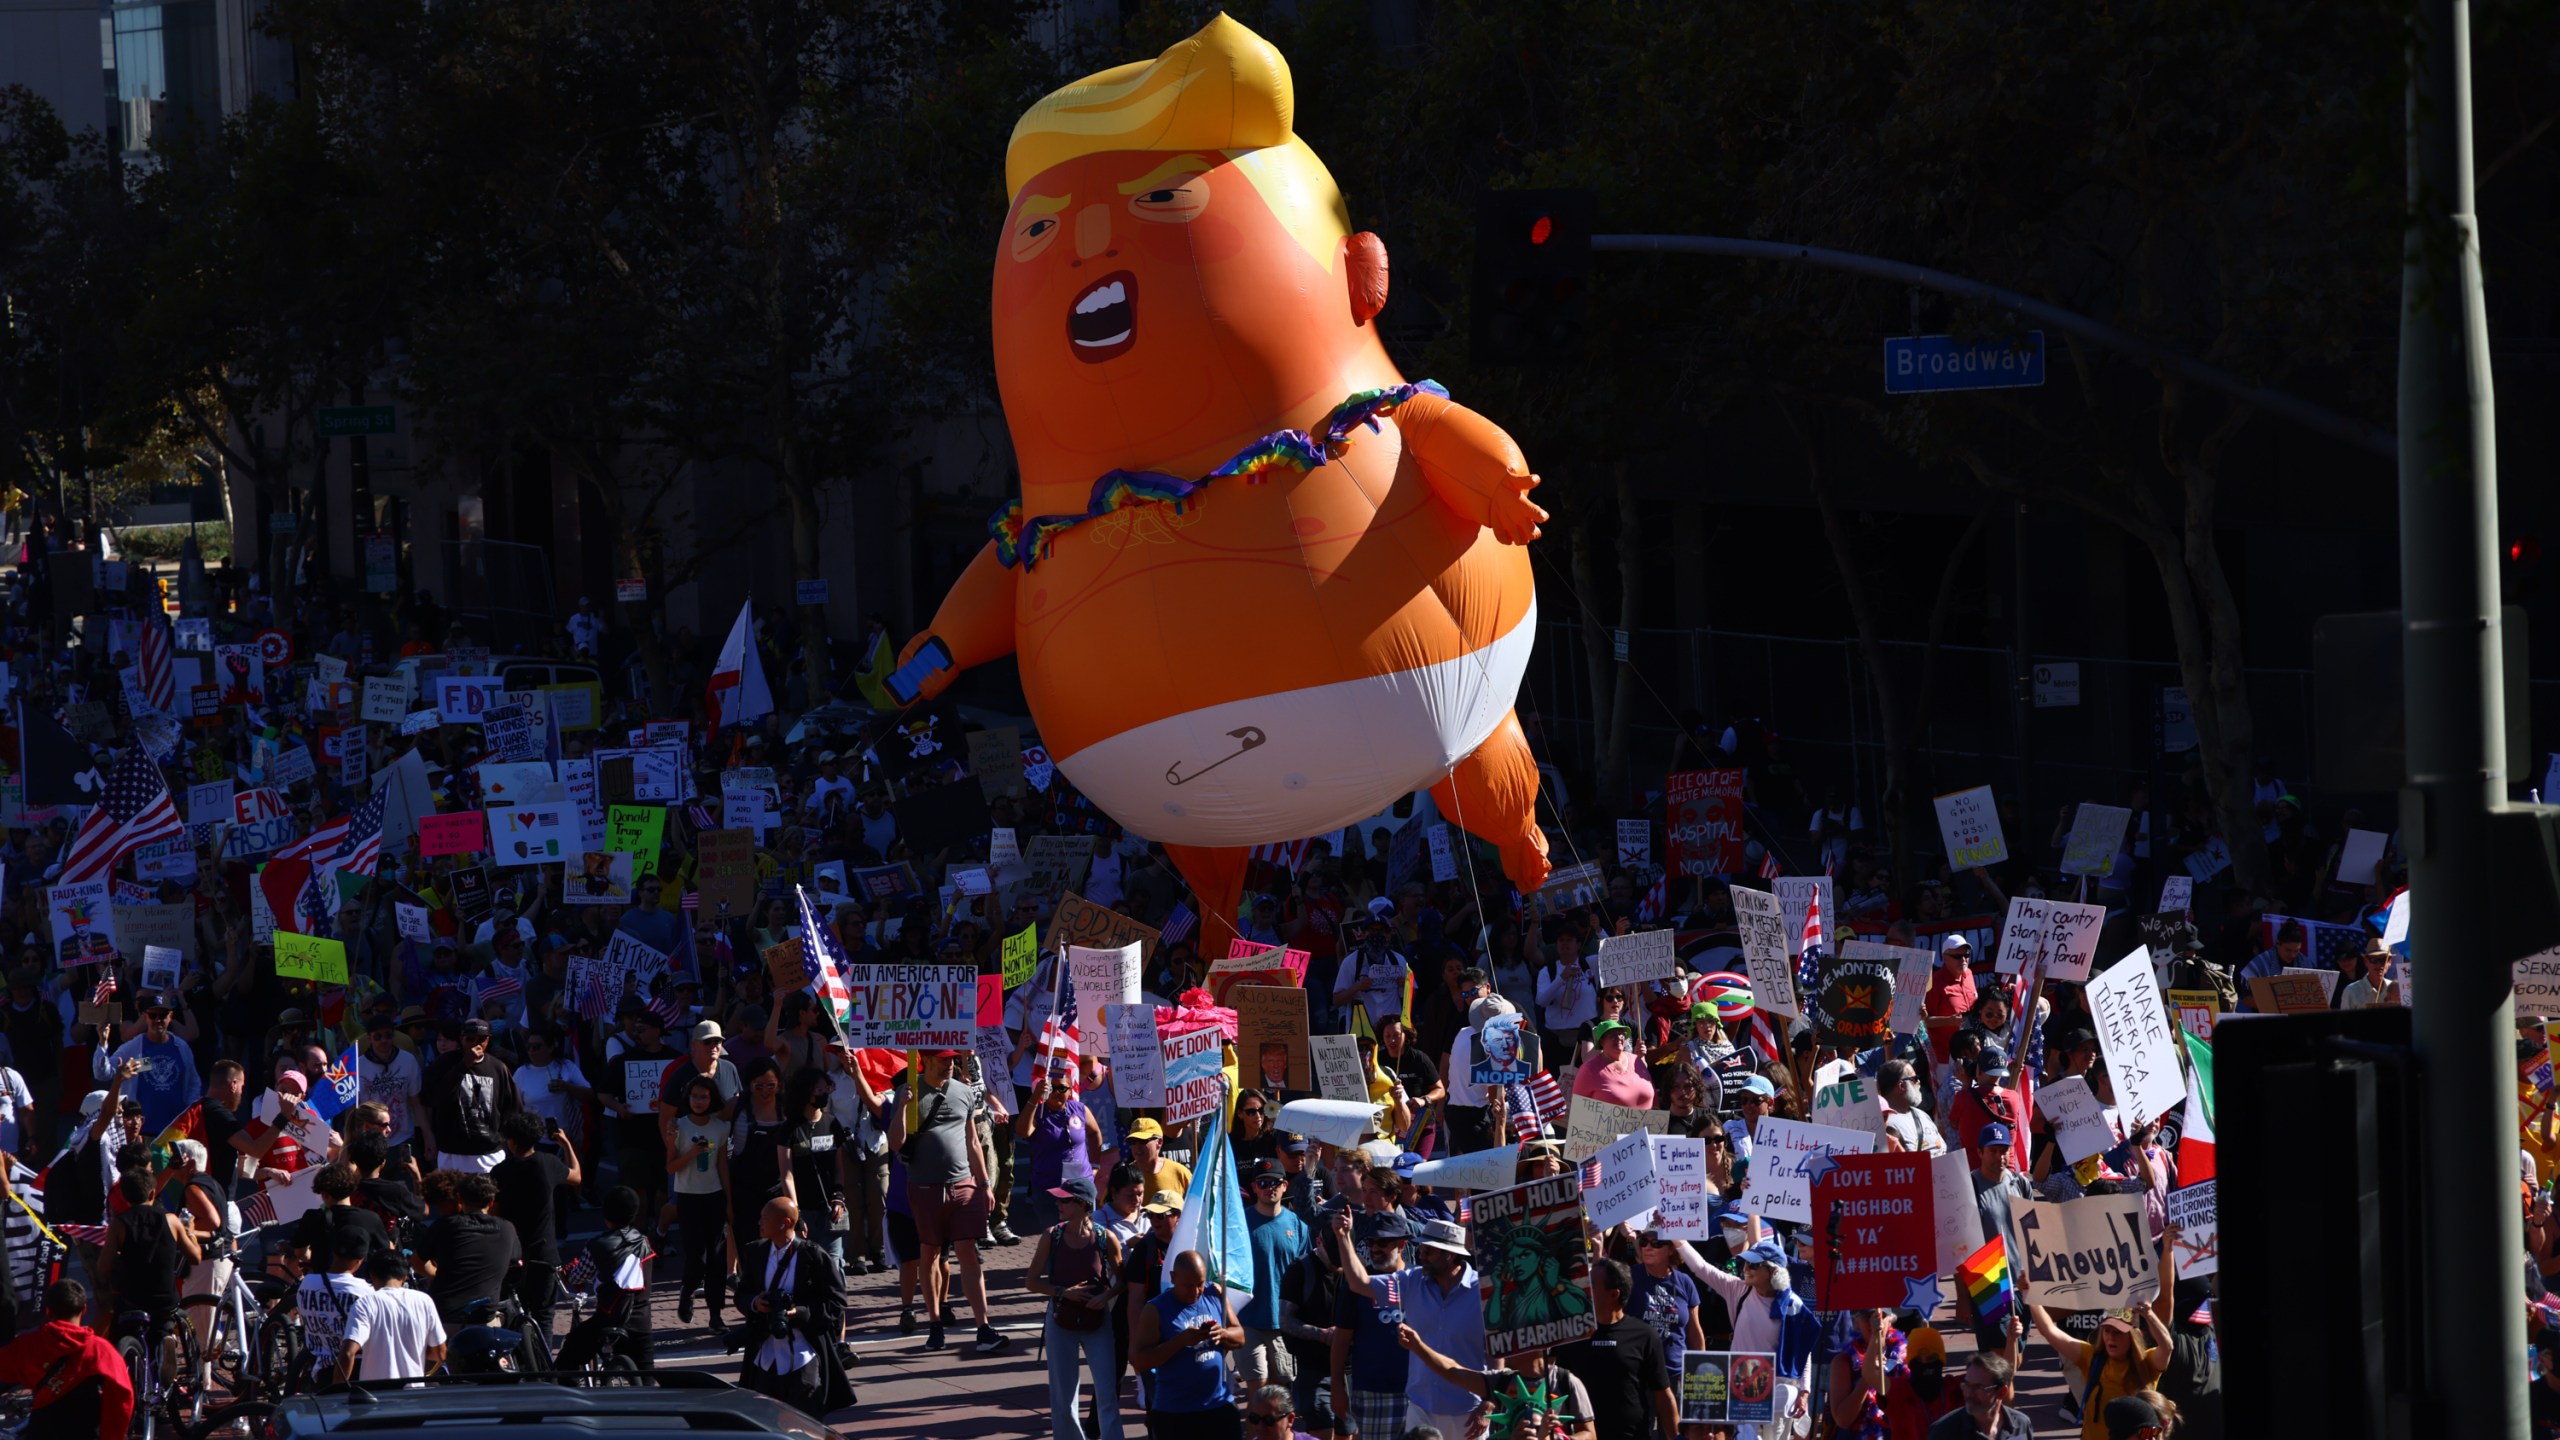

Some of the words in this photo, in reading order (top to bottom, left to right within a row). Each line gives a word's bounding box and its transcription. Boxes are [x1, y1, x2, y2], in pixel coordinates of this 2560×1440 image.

[1897, 346, 2032, 376] Broadway
[324, 416, 370, 429] Spring
[375, 414, 391, 426] St
[218, 645, 231, 657] NO
[240, 645, 261, 658] ICE
[2053, 679, 2078, 688] Metro
[509, 692, 534, 708] NO
[373, 706, 395, 716] SHIT
[486, 721, 498, 736] NO
[500, 716, 527, 735] KINGS
[488, 736, 502, 750] NO
[502, 730, 529, 746] WARS
[501, 741, 531, 757] EMPIRES
[1668, 772, 1696, 794] ICE
[1696, 770, 1718, 787] OUT
[1719, 770, 1741, 786] OF
[193, 785, 228, 807] FDT
[1667, 788, 1699, 806] WHITE
[1701, 785, 1745, 801] MEMORIAL
[1955, 797, 1970, 808] NO
[612, 808, 651, 823] Donald
[735, 806, 752, 814] AND
[614, 822, 643, 839] Trump
[1960, 817, 1975, 827] NO
[1618, 835, 1627, 844] NO
[1628, 834, 1649, 844] KINGS
[1668, 820, 1742, 848] HOSPITAL
[1965, 835, 1980, 846] NO
[1954, 837, 2003, 867] KING!
[1679, 855, 1729, 877] NOW
[52, 883, 104, 901] FAUX-KING
[1773, 881, 1791, 899] NO
[1060, 898, 1110, 937] GOD
[2017, 901, 2041, 919] This
[2052, 908, 2098, 930] country
[1784, 921, 1799, 941] NO
[2010, 923, 2049, 940] stans
[2052, 924, 2074, 942] for
[2140, 917, 2161, 932] We
[2159, 919, 2183, 941] the
[609, 937, 632, 965] HEY
[1004, 933, 1028, 959] HATE
[1601, 945, 1674, 968] REPRESENTATION
[318, 960, 346, 982] Tifa
[851, 965, 871, 982] AN
[876, 965, 940, 983] AMERICA
[947, 966, 976, 983] FOR
[1073, 962, 1113, 978] NOBEL
[1113, 956, 1138, 978] PEACE
[1602, 969, 1619, 986] IS
[1620, 959, 1675, 983] TYRANNY
[1751, 958, 1790, 982] EPSTEIN
[1113, 973, 1139, 991] PIECE
[1764, 981, 1793, 1005] FILES
[2096, 981, 2126, 1052] THINK
[2127, 971, 2163, 1046] MAKE
[865, 1021, 881, 1030] our
[884, 1020, 921, 1031] DREAM
[1836, 1017, 1886, 1038] ORANGE
[866, 1032, 892, 1046] their
[895, 1030, 969, 1046] NIGHTMARE
[1163, 1039, 1185, 1061] WE
[1187, 1029, 1222, 1056] DON'T
[1323, 1036, 1336, 1045] THE
[2114, 990, 2150, 1082] AMERICA
[1317, 1046, 1354, 1061] NATIONAL
[627, 1062, 659, 1079] Elect
[1324, 1060, 1349, 1074] GUARD
[1475, 1070, 1526, 1084] NOPE
[1166, 1085, 1184, 1107] DO
[1186, 1072, 1224, 1100] KINGS
[1320, 1076, 1330, 1086] IS
[1331, 1075, 1345, 1086] NOT
[1345, 1073, 1362, 1086] YOUR
[627, 1089, 644, 1101] Get
[1816, 1080, 1869, 1110] LOVE
[2118, 1064, 2147, 1127] AGAIN
[1166, 1105, 1178, 1122] IN
[1582, 1098, 1603, 1114] THE
[1612, 1105, 1648, 1121] ONLY
[2058, 1100, 2081, 1115] NOT
[1596, 1114, 1667, 1135] MINORITY
[1993, 1128, 2003, 1140] LA
[1755, 1124, 1779, 1148] Life
[1162, 1148, 1192, 1164] TRUMP
[1612, 1143, 1636, 1167] NOT
[1640, 1139, 1648, 1150] A
[1660, 1144, 1668, 1160] E
[1671, 1147, 1700, 1162] pluribus
[1433, 1166, 1455, 1181] NO
[1668, 1163, 1693, 1172] unum
[1832, 1170, 1873, 1188] LOVE
[1884, 1167, 1917, 1185] THY
[1602, 1170, 1627, 1190] PAID
[1660, 1177, 1678, 1196] Stay
[1680, 1181, 1702, 1195] strong
[1473, 1190, 1524, 1225] GIRL,
[1525, 1177, 1579, 1211] HOLD
[1596, 1169, 1657, 1216] PROTESTER!
[1750, 1194, 1759, 1206] a
[1764, 1189, 1802, 1214] police
[2170, 1193, 2181, 1206] NO
[2181, 1184, 2218, 1203] THRONES
[1660, 1197, 1686, 1214] Stand
[1689, 1202, 1700, 1214] up
[1829, 1198, 1914, 1217] EIGHBOR
[2170, 1204, 2182, 1218] NO
[2182, 1195, 2218, 1214] CROWNS
[1687, 1218, 1702, 1228] out
[2187, 1206, 2219, 1229] KINGS
[2019, 1207, 2149, 1296] Enough!
[1835, 1255, 1919, 1275] A##HOLES
[298, 1288, 360, 1313] WARNIN
[1642, 1310, 1680, 1324] AMERICA
[1489, 1329, 1514, 1356] MY
[1516, 1311, 1596, 1346] EARRINGS
